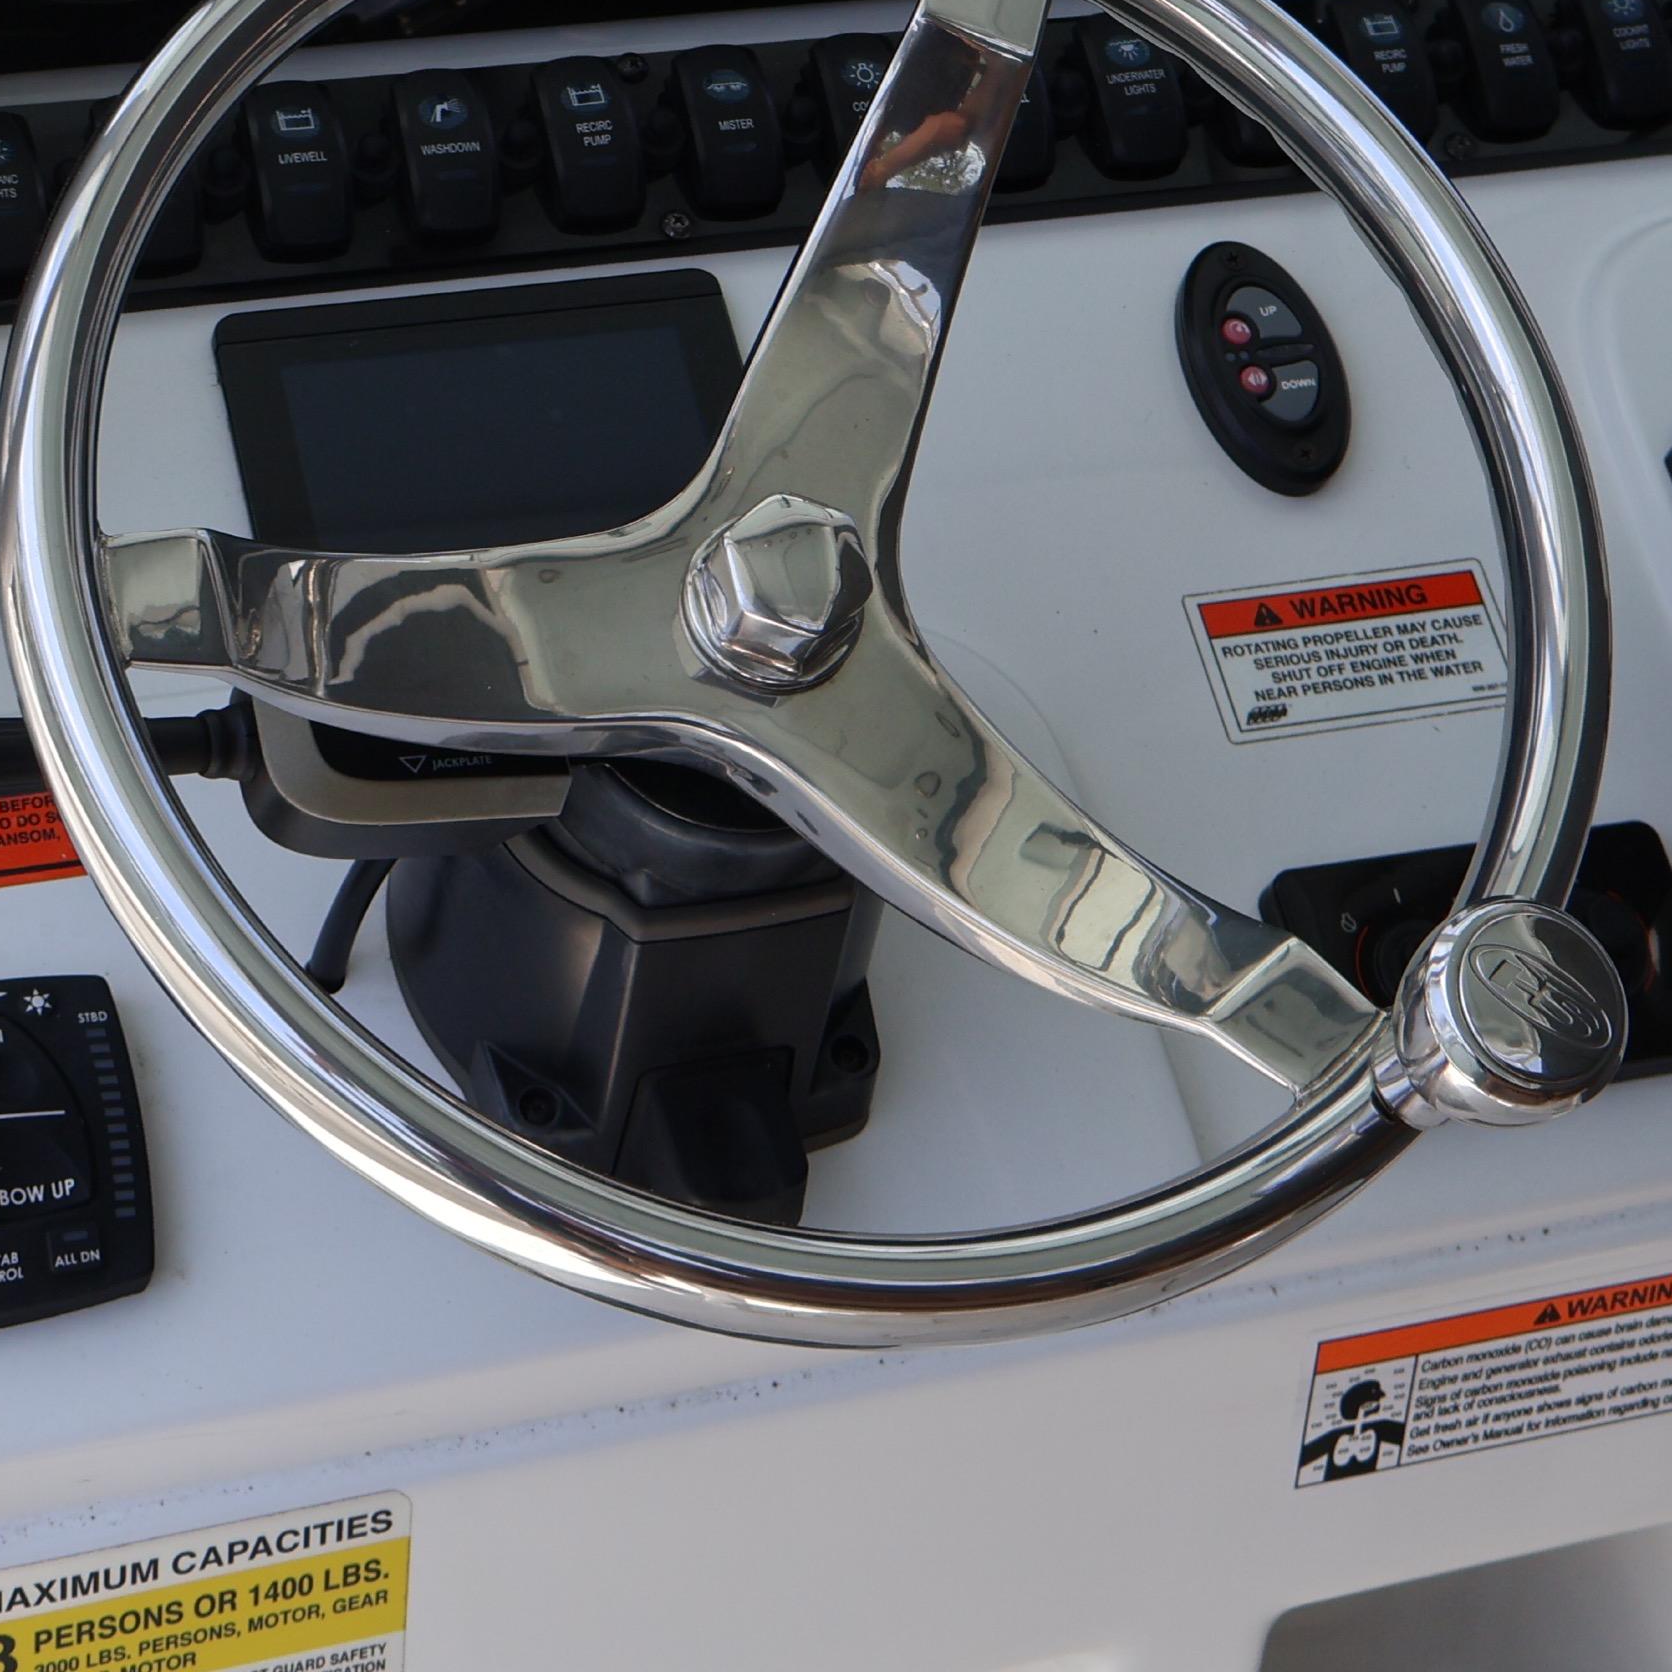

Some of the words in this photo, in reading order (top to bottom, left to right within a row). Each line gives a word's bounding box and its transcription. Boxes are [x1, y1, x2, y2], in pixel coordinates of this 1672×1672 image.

[1373, 48, 1408, 62] RECIRC
[1106, 68, 1166, 86] UNDERWATER
[1381, 62, 1407, 74] PUMP
[1124, 82, 1157, 96] LIGHTS
[576, 119, 614, 134] RECIRC
[718, 118, 755, 132] MISTER
[420, 141, 481, 157] WASHDOWN
[583, 134, 612, 147] PUMP
[278, 151, 328, 165] LIVEWELL
[1259, 305, 1277, 317] UP
[1280, 378, 1317, 391] DOWN
[1289, 584, 1427, 619] WARNING
[1222, 638, 1299, 658] ROTATING
[1301, 624, 1394, 648] PROPELLER
[1396, 621, 1426, 635] MAY
[1430, 614, 1483, 631] CAUSE
[1253, 650, 1322, 670] SERIOUS
[1325, 642, 1378, 660] INJURY
[1383, 639, 1406, 653] OR
[1409, 632, 1464, 649] DEATH.
[1271, 668, 1312, 684] SHUT
[1317, 663, 1346, 678] OFF
[1350, 655, 1407, 673] ENGINE
[1410, 649, 1457, 664] WHEN
[1254, 686, 1298, 702] NEAR
[1301, 675, 1375, 696] PERSONS
[1377, 673, 1394, 685] IN
[1396, 668, 1428, 683] THE
[1430, 660, 1484, 678] WATER
[432, 755, 493, 771] JACKPLATE
[0, 795, 55, 813] BEFOR
[17, 813, 41, 827] DO
[78, 1010, 108, 1023] STBD
[51, 1178, 75, 1199] UP
[54, 1252, 77, 1267] ALL
[80, 1249, 101, 1263] DN
[1421, 1355, 1464, 1373] Carbon
[1466, 1343, 1522, 1363] monoxide
[1525, 1336, 1552, 1354] (CO)
[1555, 1333, 1576, 1346] can
[1578, 1326, 1612, 1341] cause
[1614, 1319, 1643, 1334] brain
[1418, 1373, 1458, 1390] Engine
[1461, 1368, 1483, 1381] and
[1485, 1356, 1540, 1380] generator
[1542, 1347, 1587, 1365] exhaust
[1589, 1338, 1636, 1356] contains
[1415, 1394, 1447, 1410] Signs
[1450, 1389, 1462, 1401] of
[1464, 1381, 1503, 1398] carbon
[1506, 1370, 1561, 1387] monoxide
[1562, 1359, 1617, 1381] poisoning
[1619, 1350, 1659, 1367] include
[1409, 1425, 1431, 1440] Get
[1433, 1420, 1462, 1434] fresh
[1465, 1415, 1479, 1425] air
[1482, 1412, 1490, 1424] if
[1492, 1406, 1533, 1424] anyone
[1536, 1397, 1572, 1413] shows
[1574, 1391, 1604, 1406] signs
[1607, 1386, 1619, 1399] of
[1620, 1380, 1658, 1396] carbon
[1413, 1409, 1435, 1422] and
[1437, 1403, 1460, 1417] lack
[1463, 1399, 1475, 1411] of
[1407, 1444, 1429, 1457] See
[1432, 1433, 1480, 1452] Owner's
[1482, 1423, 1524, 1442] Manual
[1526, 1421, 1542, 1431] for
[1544, 1407, 1606, 1429] information
[1608, 1397, 1661, 1416] regarding
[172, 1510, 392, 1575] CAPACITIES
[34, 1601, 184, 1654] PERSONS
[194, 1589, 238, 1619] OR
[249, 1573, 314, 1607] 1400
[324, 1559, 389, 1592] LBS.
[86, 1645, 131, 1667] LBS.
[138, 1623, 242, 1656] PERSONS,
[248, 1603, 325, 1633] MOTOR,
[332, 1590, 389, 1614] GEAR
[330, 1642, 387, 1665] SAFETY
